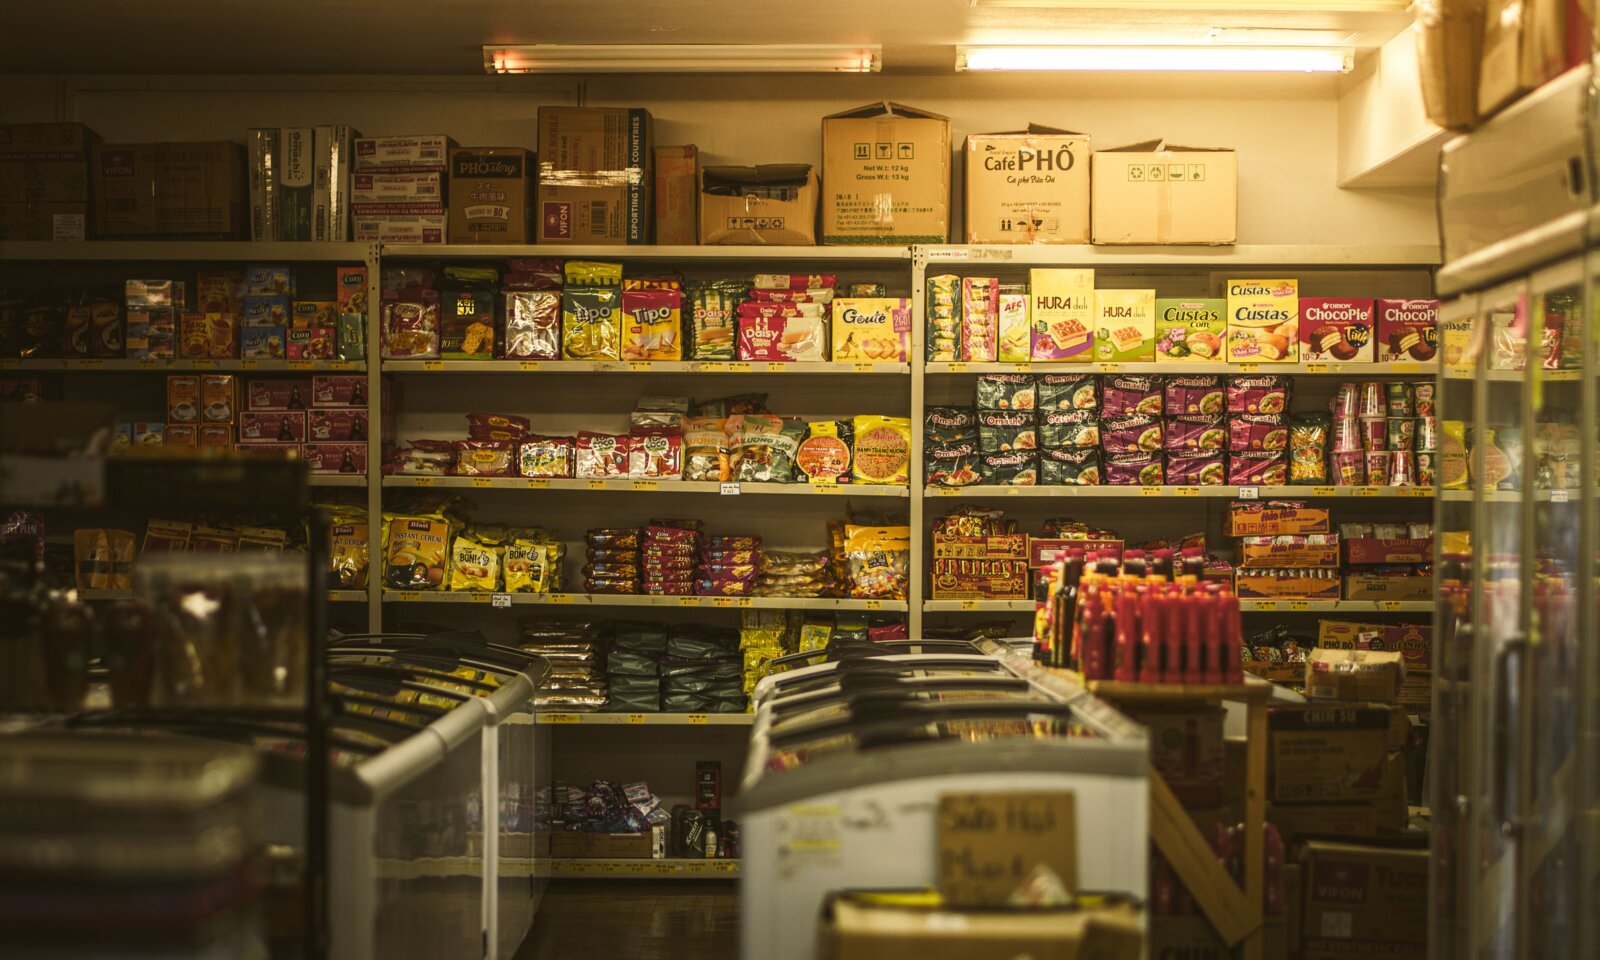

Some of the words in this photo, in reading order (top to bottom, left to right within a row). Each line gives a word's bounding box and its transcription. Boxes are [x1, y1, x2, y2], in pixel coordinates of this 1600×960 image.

[632, 116, 642, 162] COUNTRIES
[985, 155, 1016, 171] Café
[1018, 142, 1075, 171] PHỐ
[103, 166, 133, 176] VIFON
[901, 165, 909, 173] kg
[900, 174, 909, 182] kg
[560, 205, 568, 236] VIFON
[631, 192, 641, 239] EXPORTING
[769, 292, 787, 300] Daisy
[1230, 284, 1271, 296] Custas
[1004, 301, 1022, 312] AFC
[1037, 296, 1071, 310] HURA
[1073, 297, 1088, 310] deli
[631, 306, 671, 325] Tipo
[698, 309, 731, 321] Daisy
[843, 308, 886, 324] Gouté
[1103, 306, 1132, 318] HURA
[1133, 307, 1146, 318] deli
[1163, 307, 1219, 322] Custas
[1235, 306, 1289, 321] Custas
[1305, 307, 1368, 321] ChocoPie
[1385, 308, 1438, 322] ChocoPi
[746, 329, 779, 341] Daisy
[1302, 352, 1310, 361] 10
[1381, 354, 1389, 362] 10
[1114, 378, 1150, 390] Omachi
[1177, 377, 1212, 387] Omachi
[420, 533, 442, 543] CEREAL
